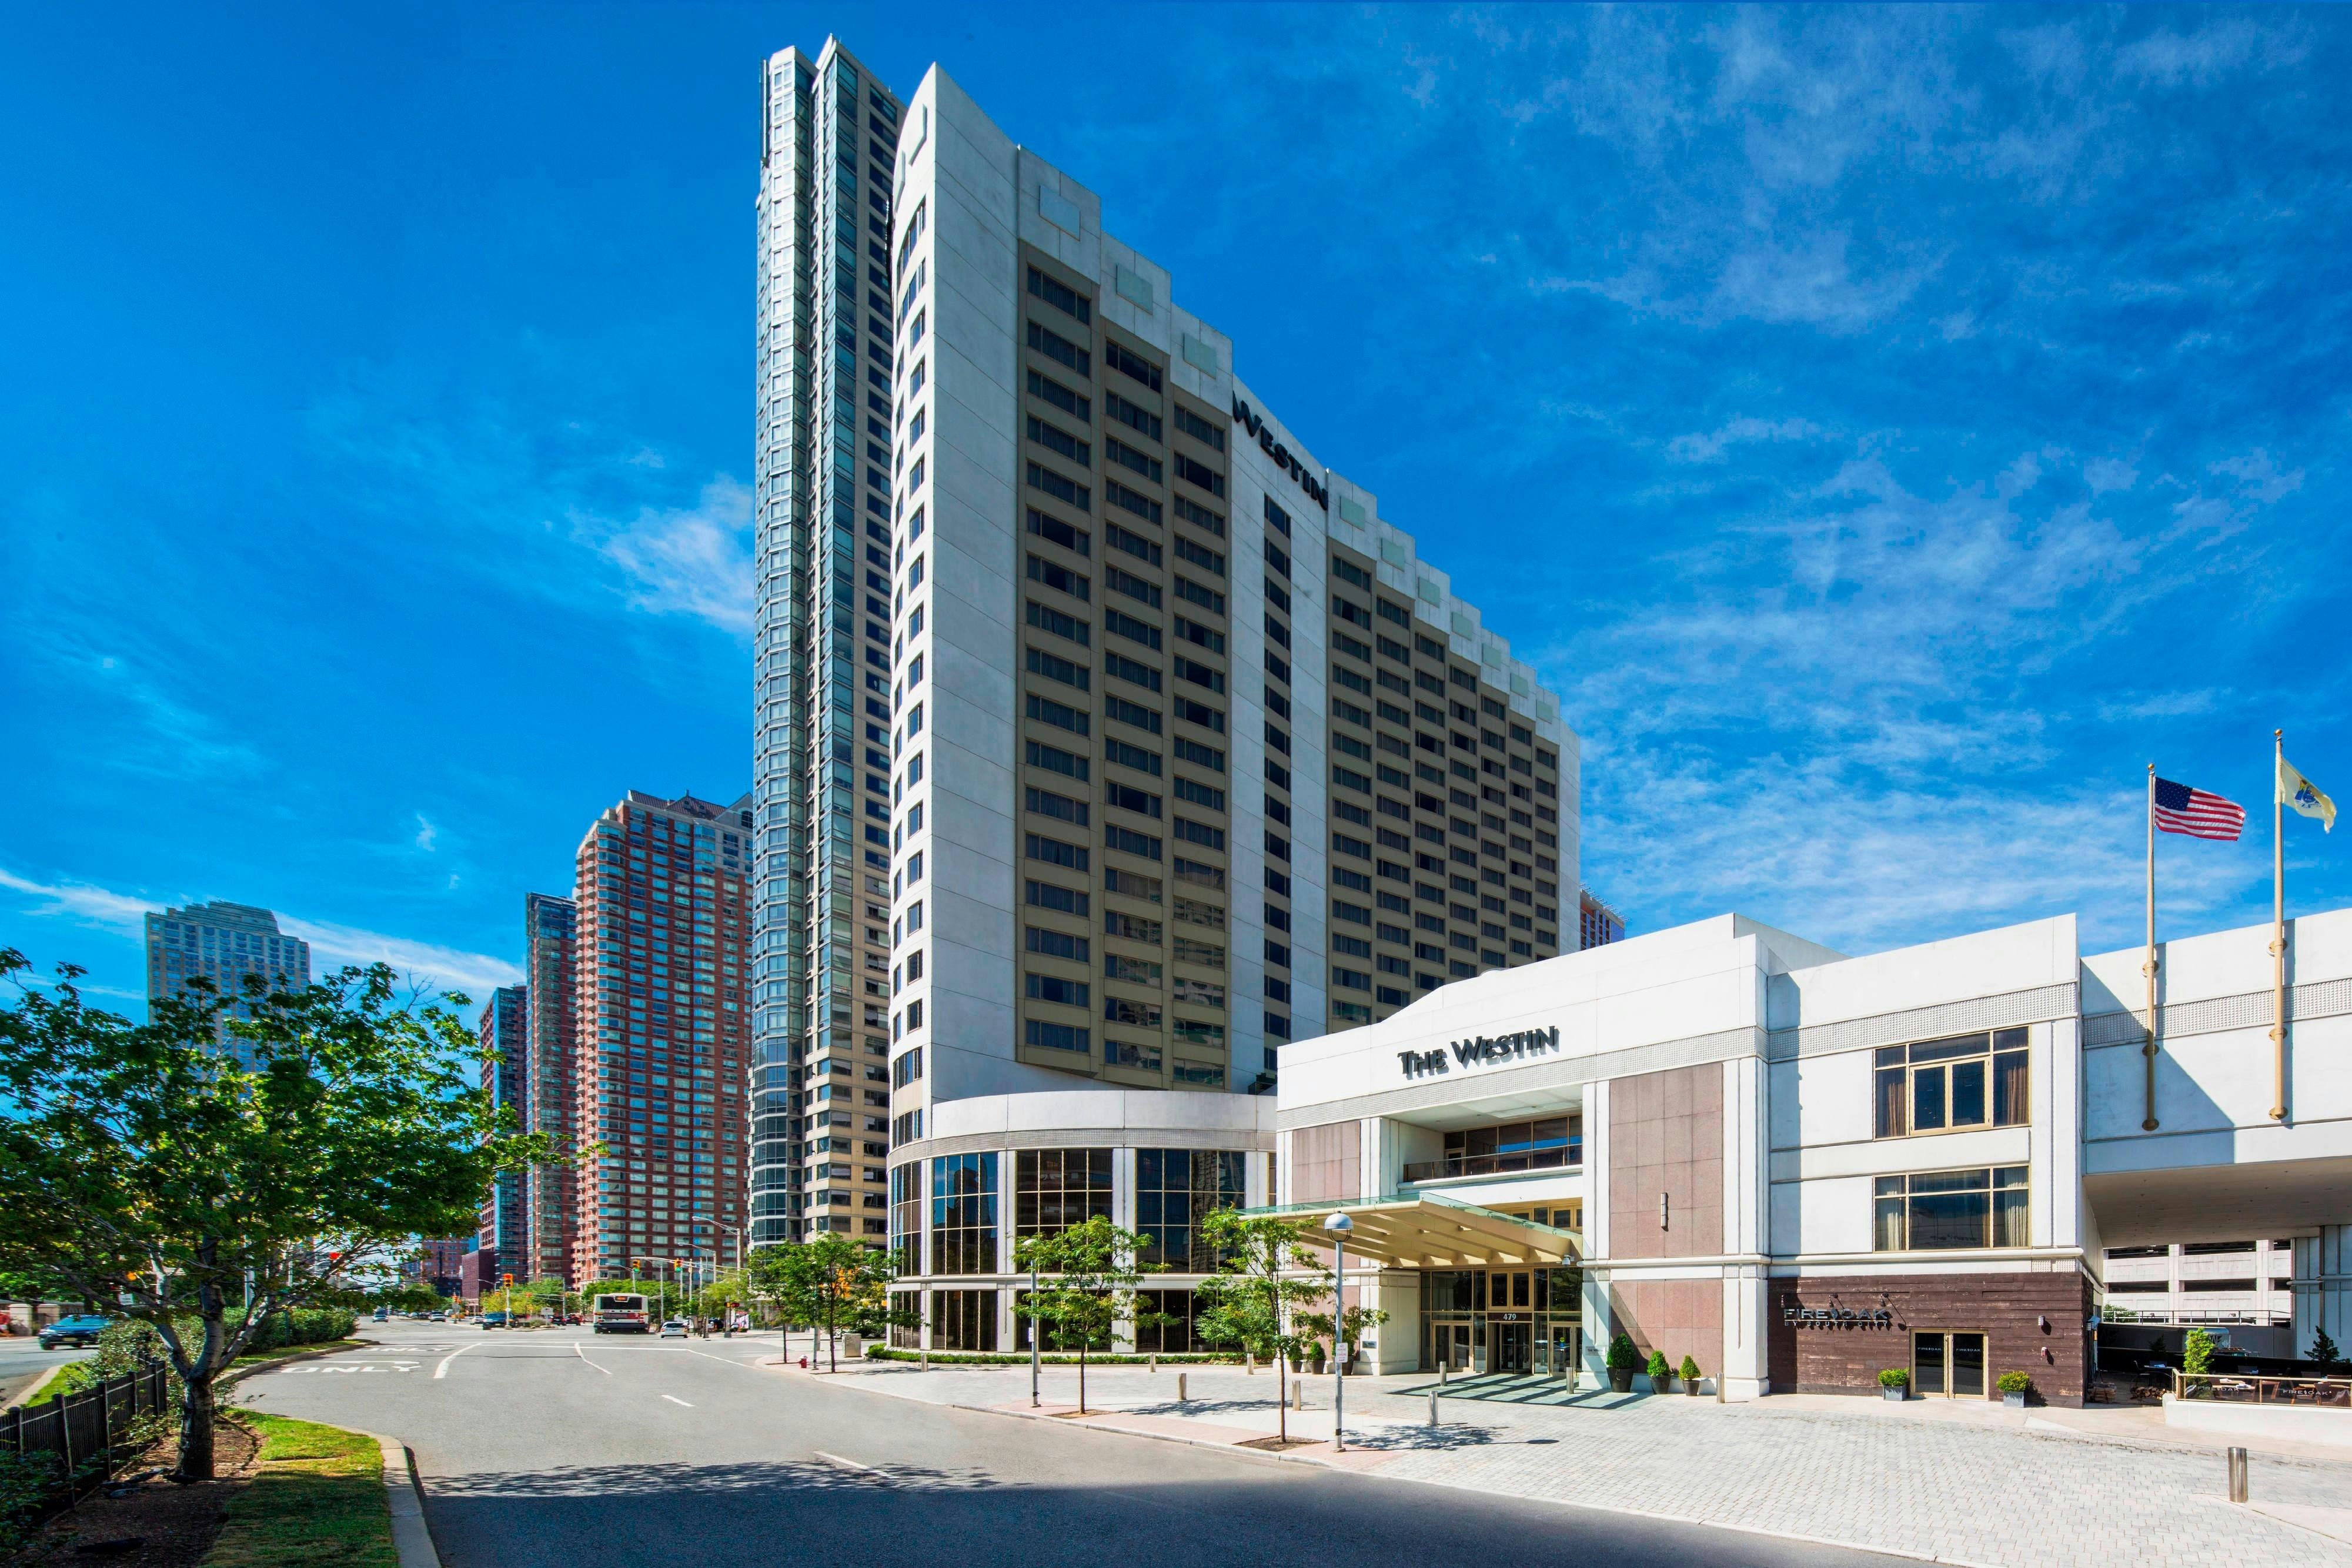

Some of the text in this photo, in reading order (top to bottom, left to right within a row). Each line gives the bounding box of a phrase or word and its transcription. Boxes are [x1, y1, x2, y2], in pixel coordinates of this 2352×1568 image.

[1232, 390, 1329, 511] WESTIN
[1397, 1025, 1557, 1074] THE WESTIN
[1783, 1308, 1888, 1319] FIRE OAK
